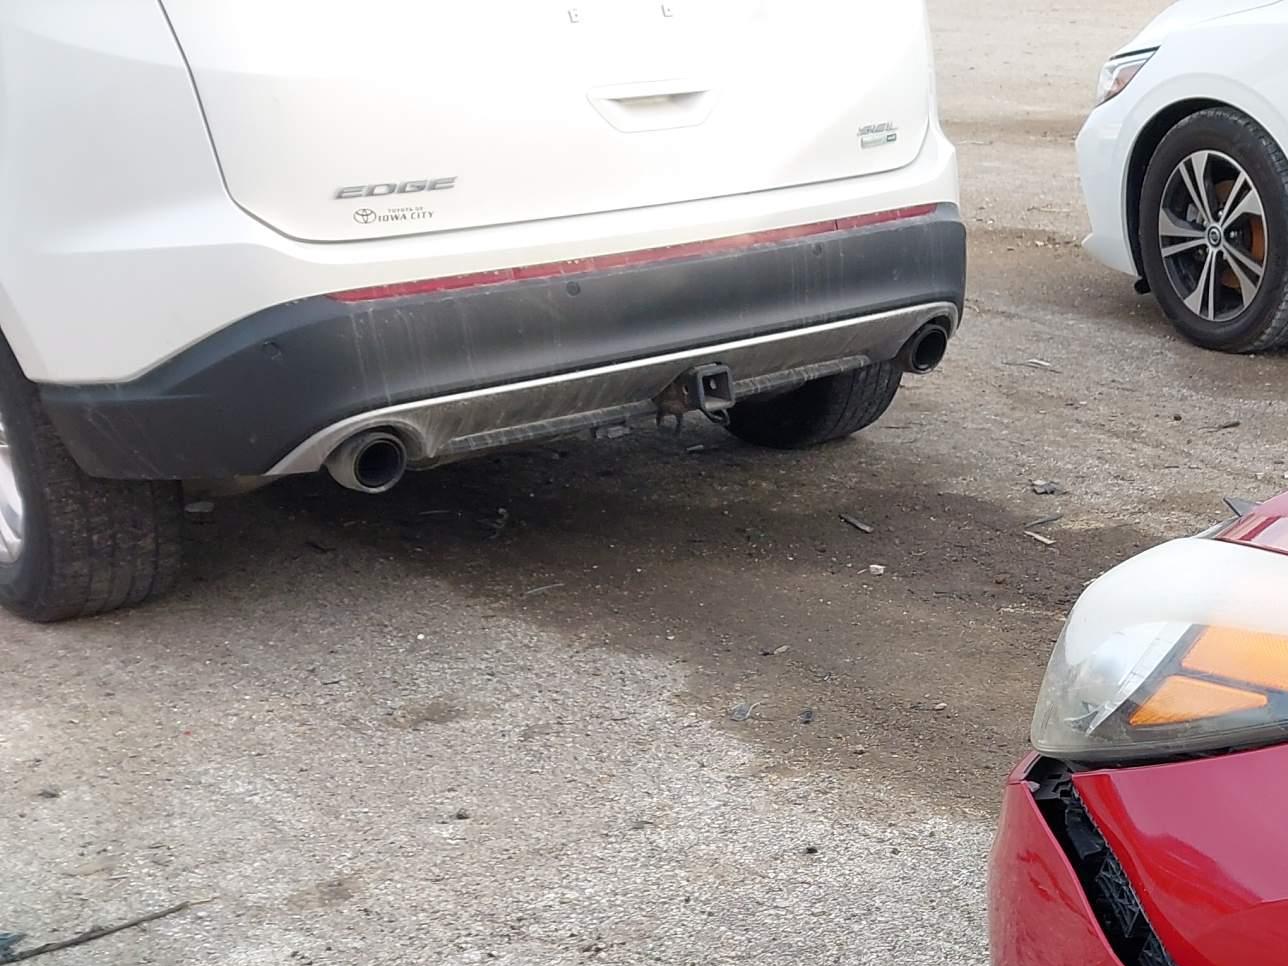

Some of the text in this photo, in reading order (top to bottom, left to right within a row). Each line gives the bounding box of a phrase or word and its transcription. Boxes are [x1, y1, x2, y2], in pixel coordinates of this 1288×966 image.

[334, 176, 458, 201] EDGE
[378, 211, 434, 223] IOWA CITY
